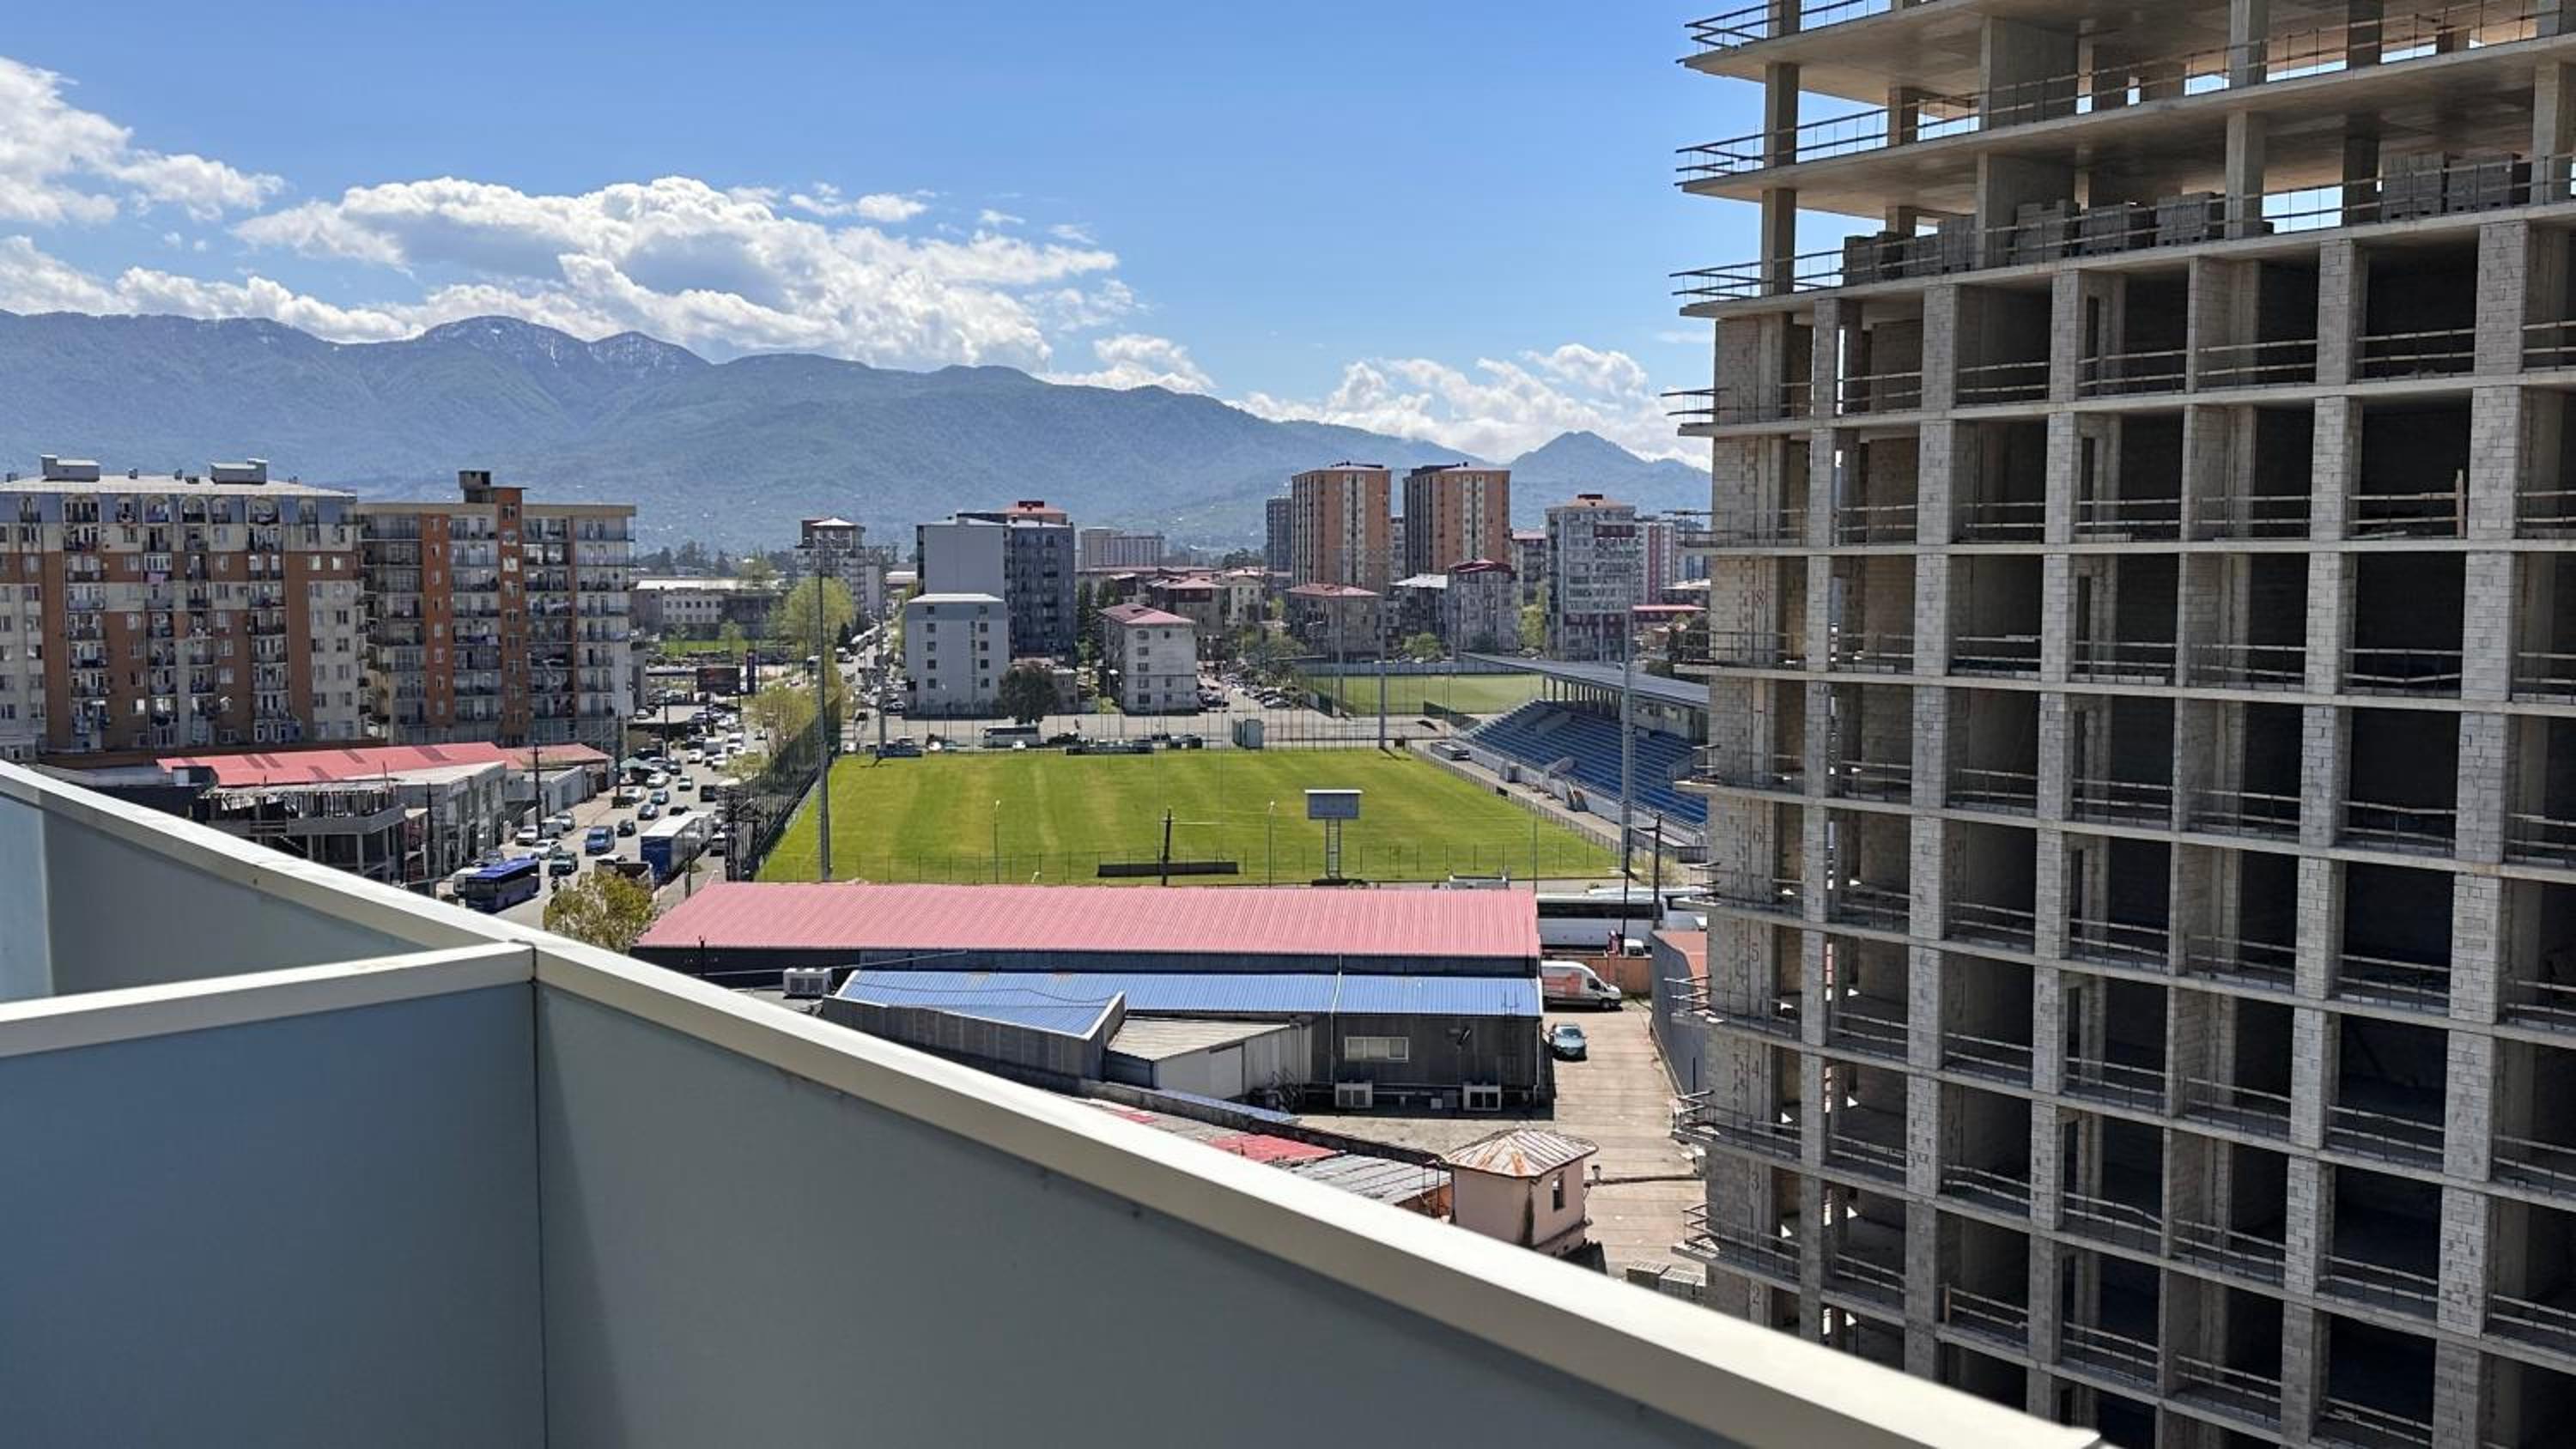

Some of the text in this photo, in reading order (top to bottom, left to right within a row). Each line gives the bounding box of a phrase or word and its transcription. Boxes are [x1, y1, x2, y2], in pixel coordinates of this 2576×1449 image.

[1751, 943, 1759, 961] 5
[1751, 1061, 1759, 1078] 4
[1751, 1172, 1759, 1190] 3
